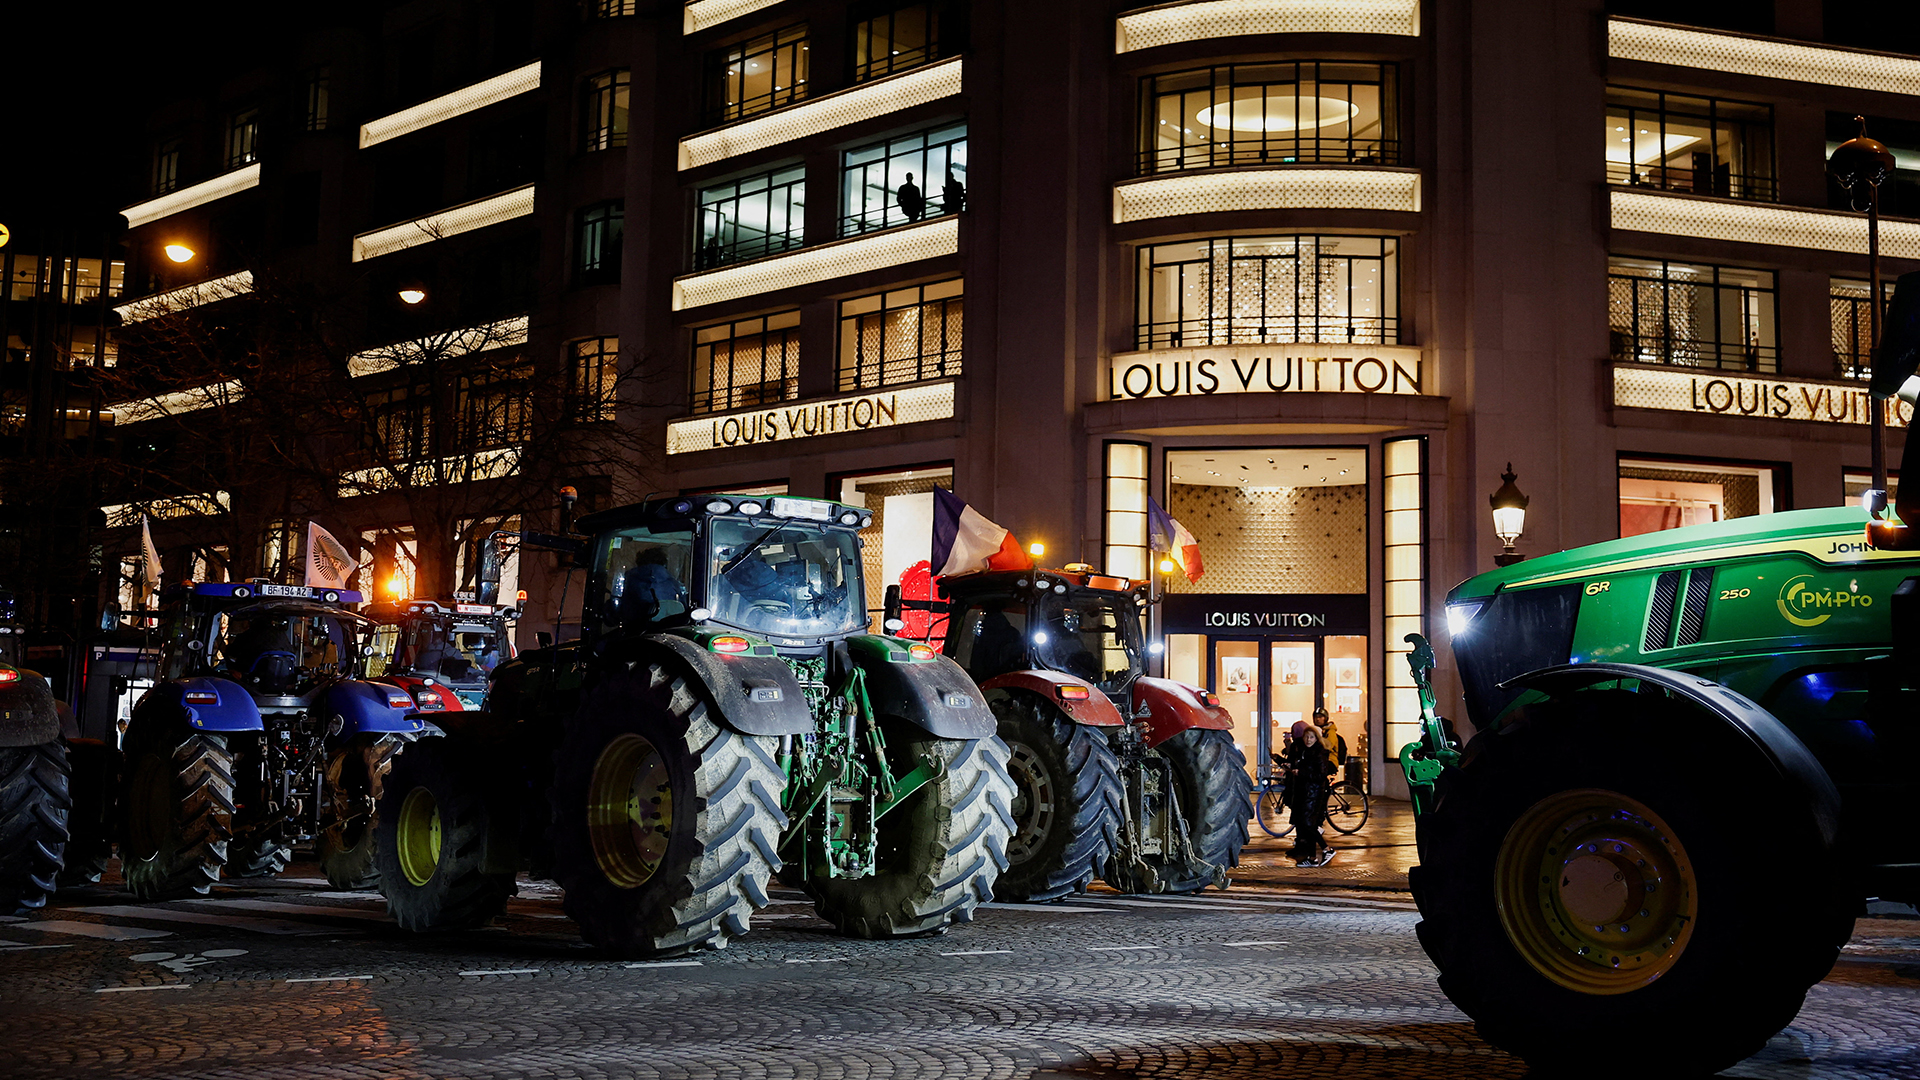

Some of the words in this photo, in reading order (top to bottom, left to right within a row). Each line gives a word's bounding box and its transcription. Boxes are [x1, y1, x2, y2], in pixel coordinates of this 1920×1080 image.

[1109, 358, 1220, 399] LOUIS
[1231, 357, 1422, 395] VUITTON
[1691, 378, 1792, 417] LOUIS
[712, 412, 778, 448] LOUIS
[785, 395, 896, 438] VUITTON
[1585, 581, 1611, 596] 6R
[1719, 588, 1751, 600] 250
[1205, 612, 1250, 627] LOUIS
[1254, 612, 1325, 627] VUITTON
[95, 652, 103, 660] P
